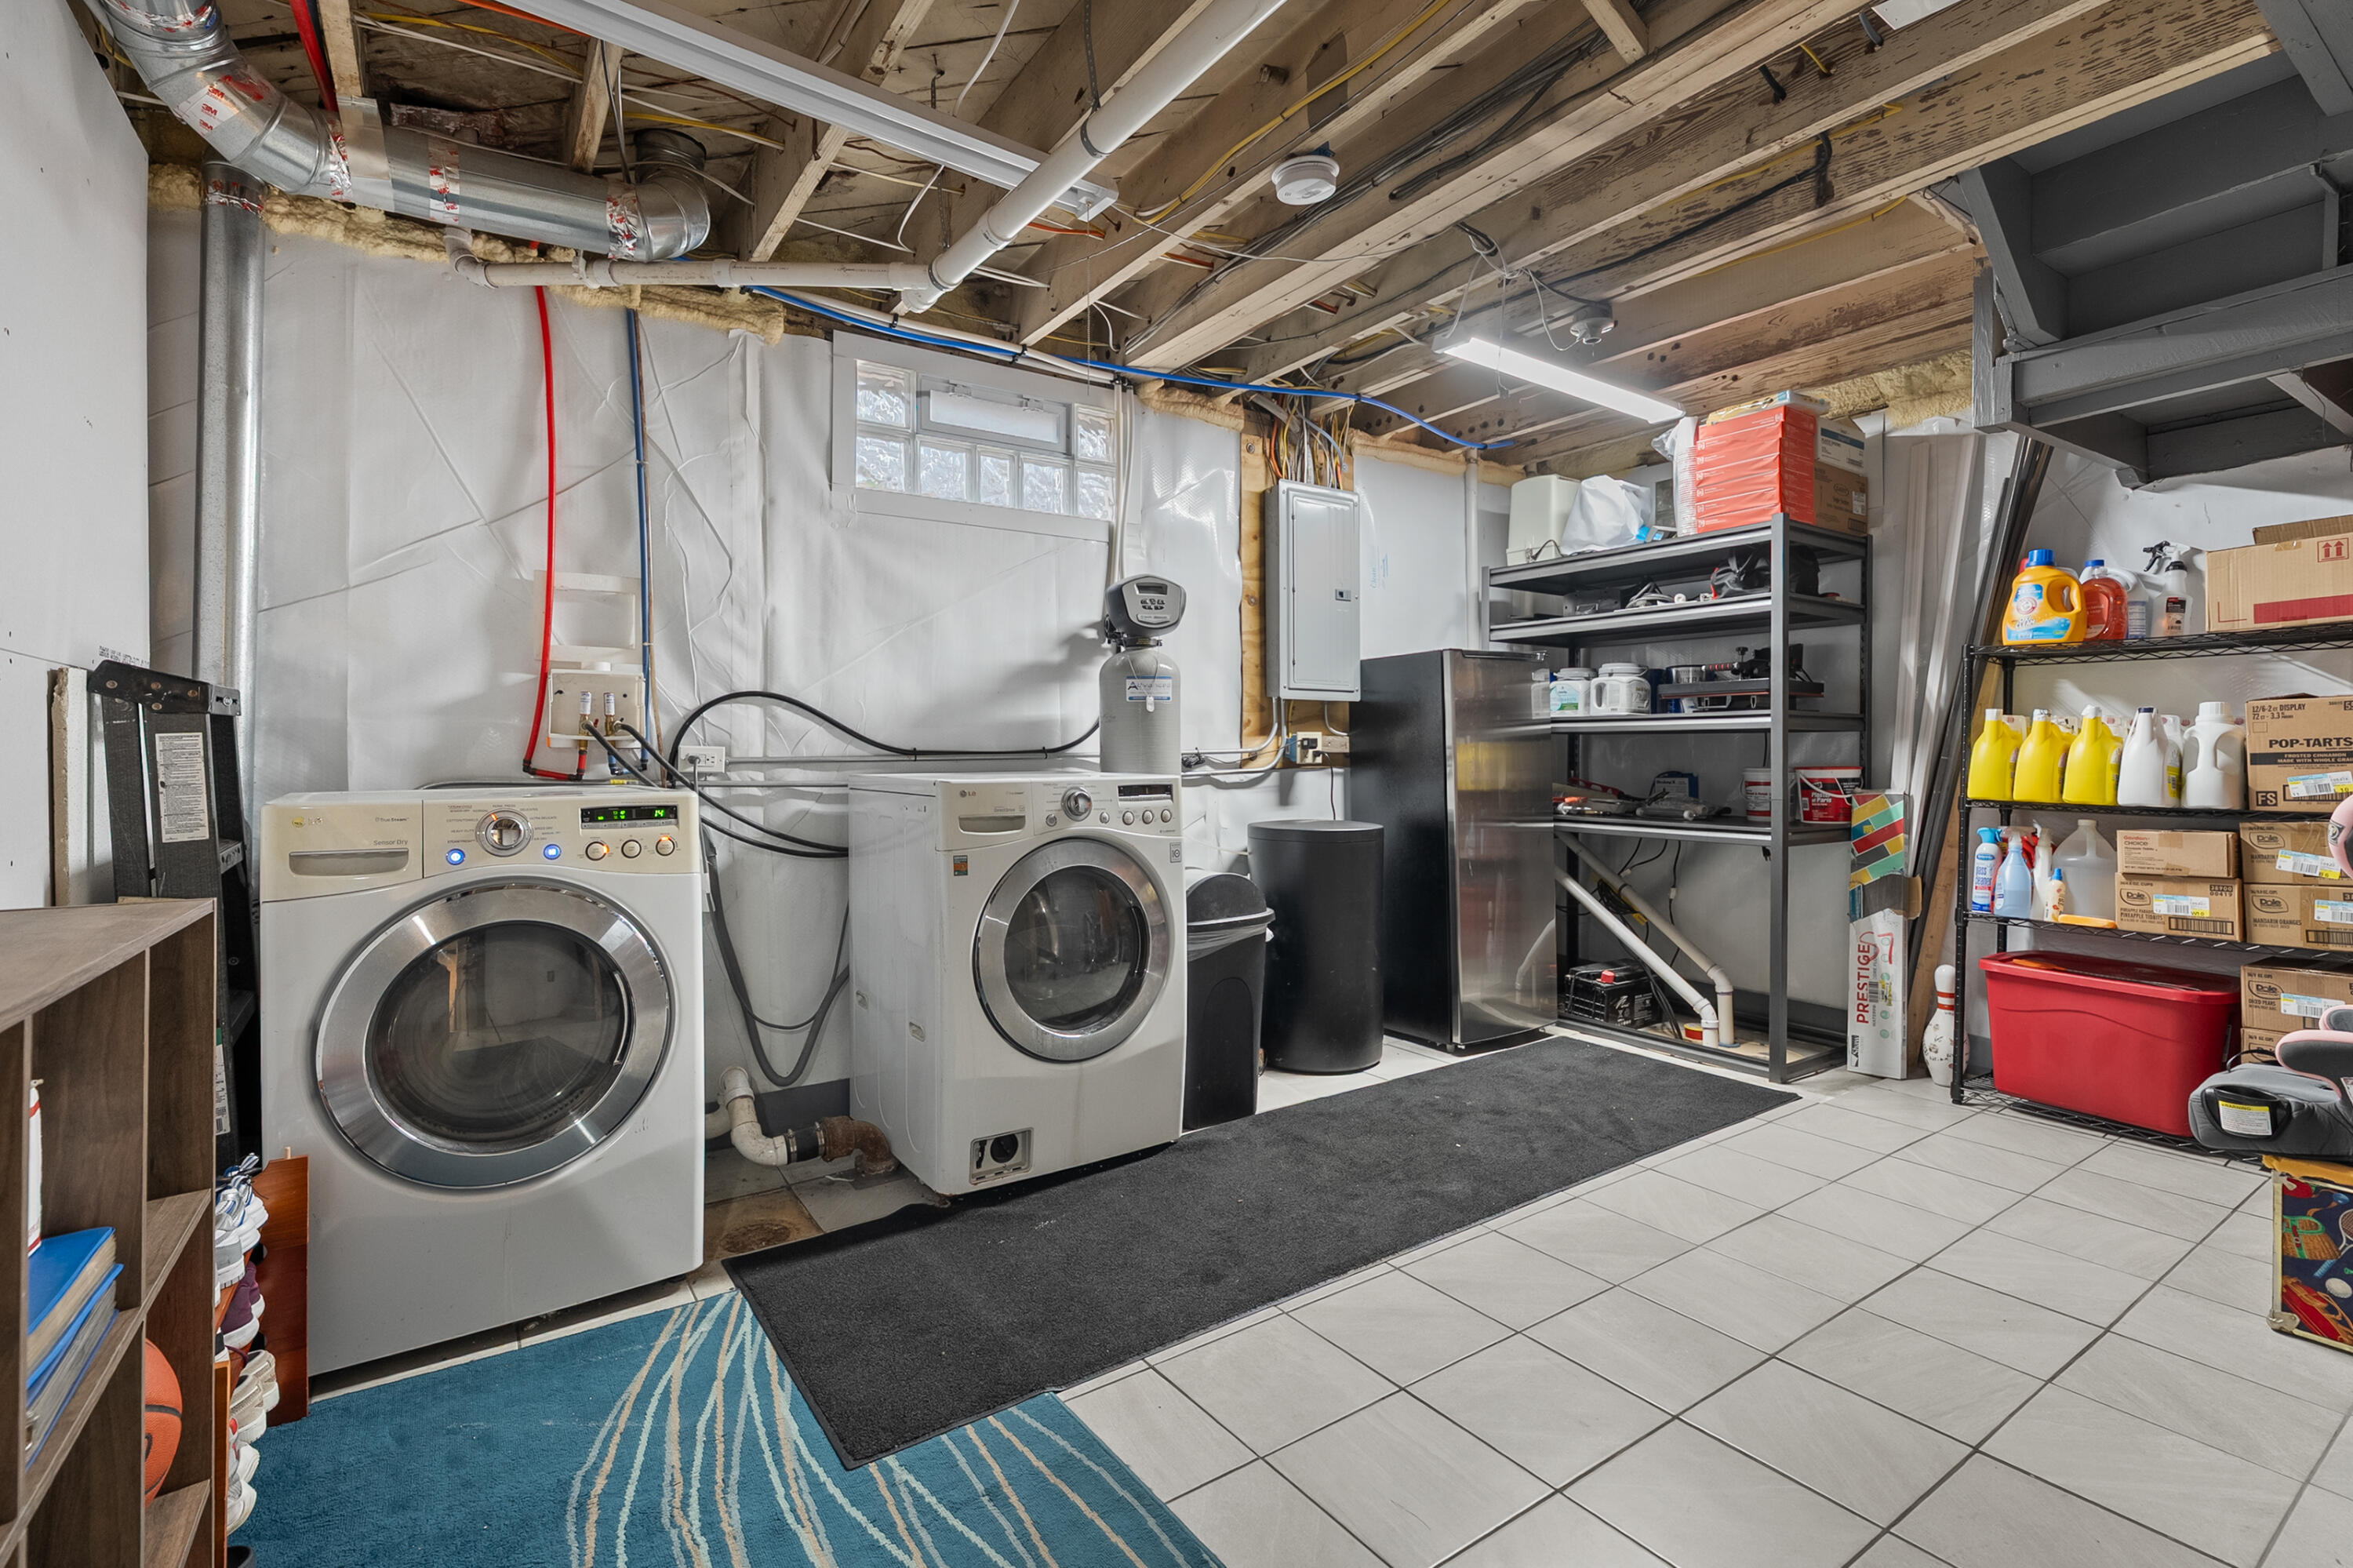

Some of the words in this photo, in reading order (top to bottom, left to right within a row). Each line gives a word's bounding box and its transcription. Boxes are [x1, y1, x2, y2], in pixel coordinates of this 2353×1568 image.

[208, 85, 225, 98] 3M
[202, 104, 217, 115] 3M
[199, 119, 213, 130] 3M
[2268, 737, 2353, 748] POP-TARTS
[2258, 792, 2276, 805] FS
[1857, 944, 1870, 1024] PRESTIGE
[2256, 984, 2278, 993] Dole
